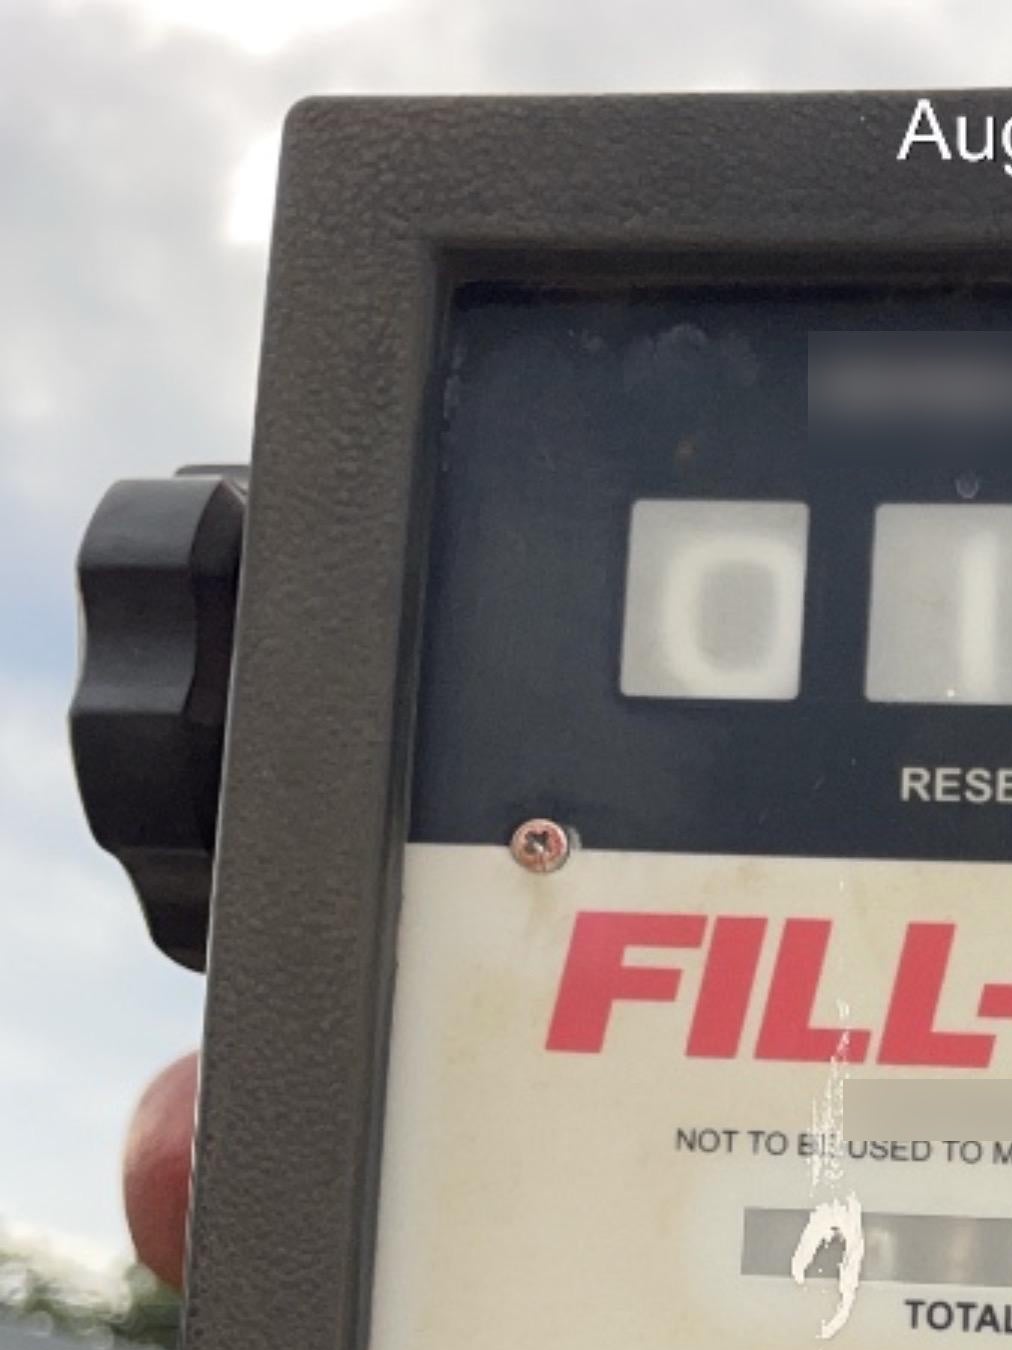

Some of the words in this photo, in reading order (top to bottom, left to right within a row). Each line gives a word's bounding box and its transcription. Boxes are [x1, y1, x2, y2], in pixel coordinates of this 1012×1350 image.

[675, 1127, 739, 1154] NOT
[746, 1130, 789, 1157] TO
[847, 1139, 932, 1163] USED
[946, 1140, 984, 1165] TO
